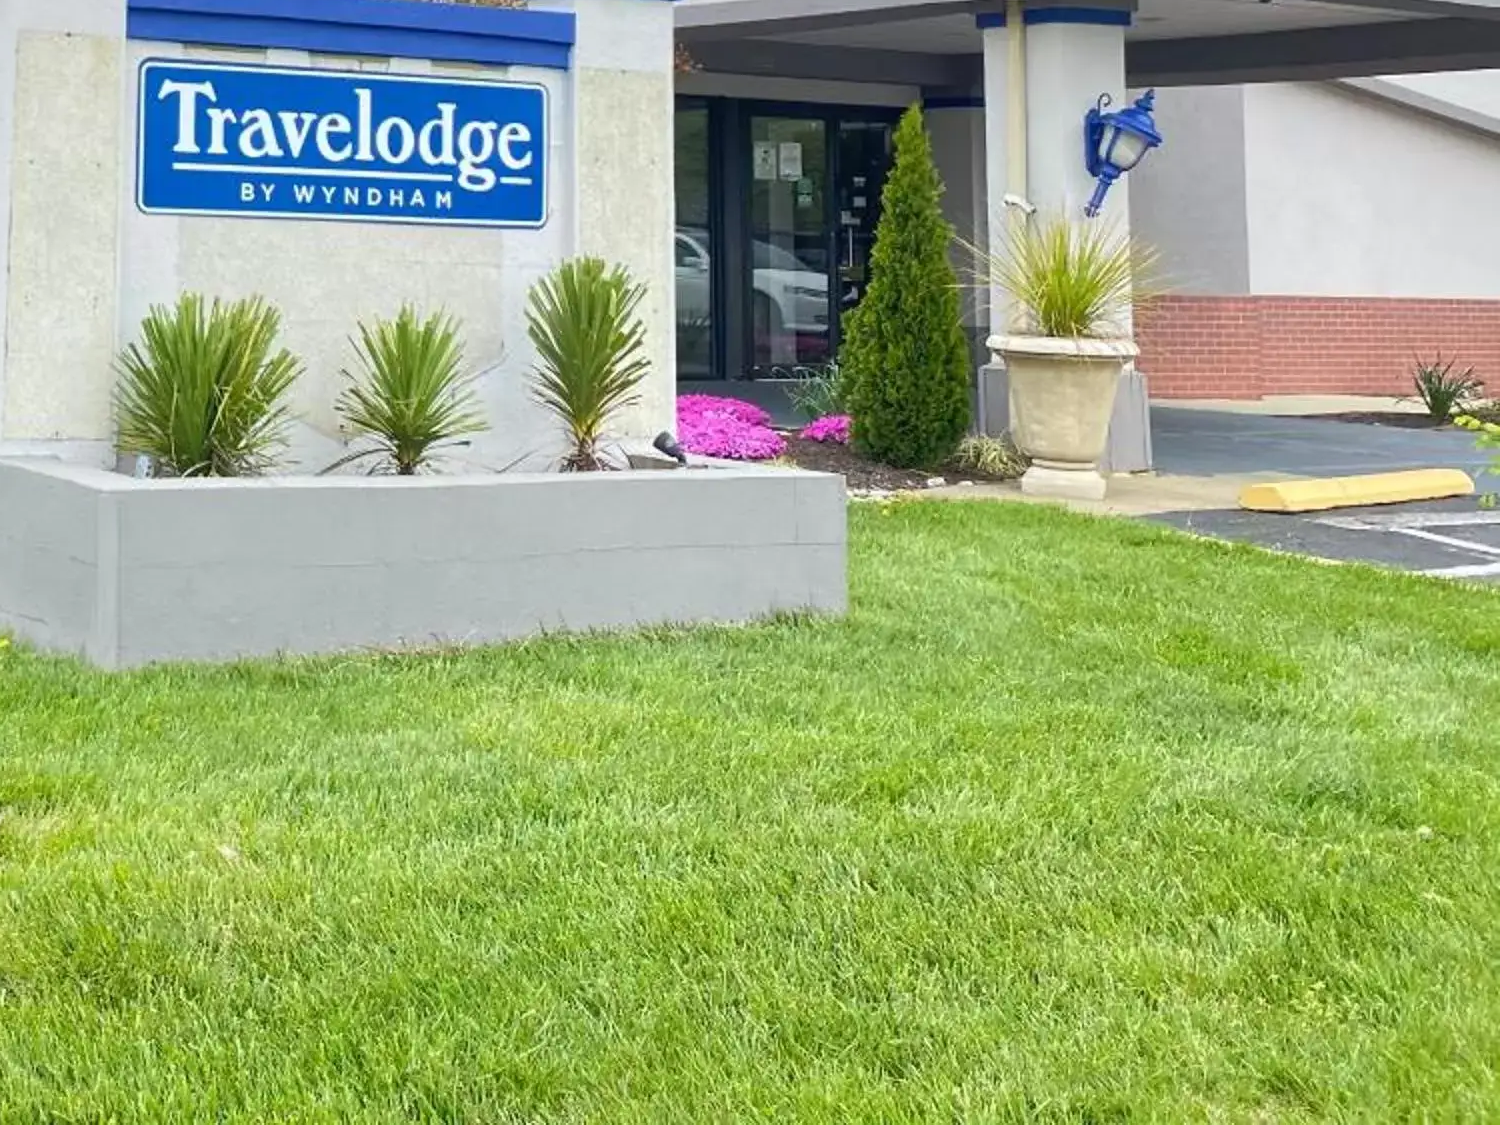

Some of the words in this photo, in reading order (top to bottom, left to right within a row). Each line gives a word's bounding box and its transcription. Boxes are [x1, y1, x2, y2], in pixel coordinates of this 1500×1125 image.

[158, 79, 532, 192] Travelodge
[240, 182, 275, 203] BY
[293, 184, 453, 210] WYNDHAM
